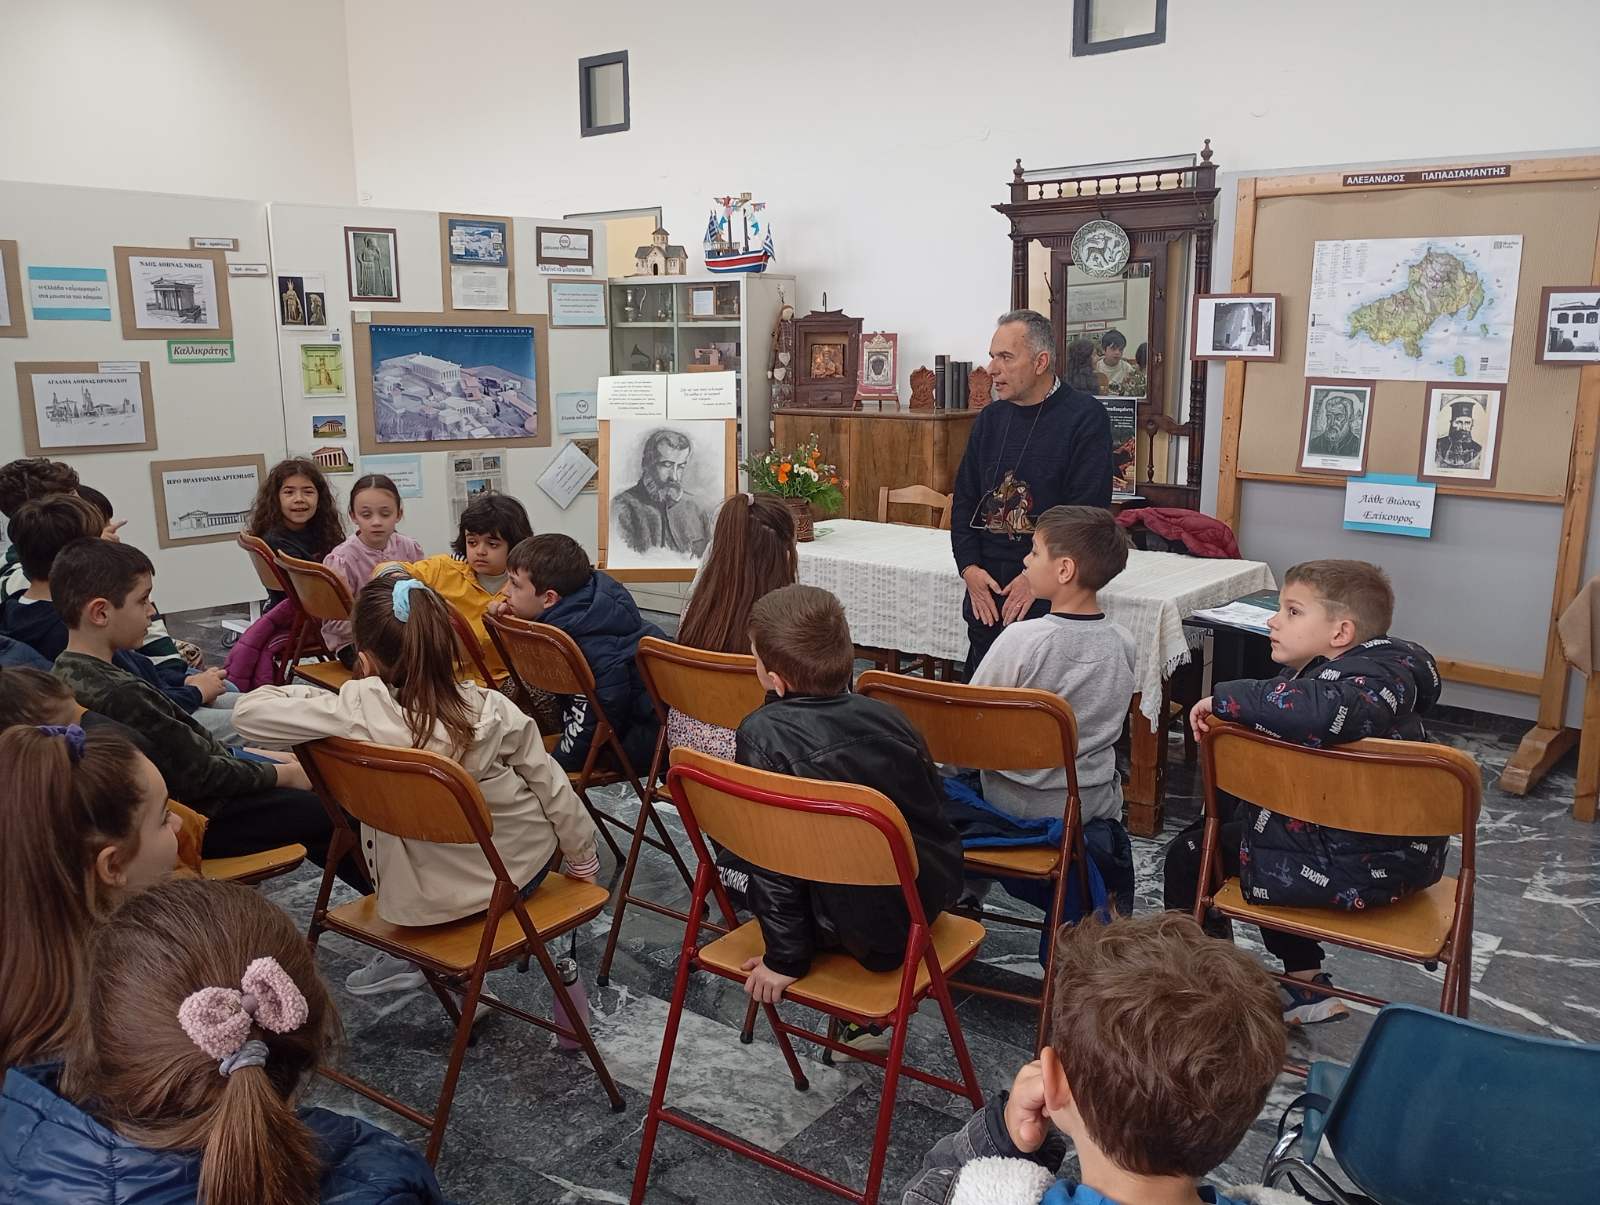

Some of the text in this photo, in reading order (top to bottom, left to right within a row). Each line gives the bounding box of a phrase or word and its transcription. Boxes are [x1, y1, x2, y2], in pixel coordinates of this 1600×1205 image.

[1346, 167, 1507, 185] ΑΛΕΞΑΝΔΡΟΣ ΠΑΠΑΔΙΑΜΑΝΤΗΣ
[173, 345, 229, 356] Καλλικράτης
[1358, 494, 1421, 509] Λάθε Βιώσας
[1362, 511, 1414, 524] Επίκουρος
[1328, 705, 1349, 735] MARVEL
[1253, 807, 1272, 834] MARVEL
[1299, 864, 1331, 888] MARVEL
